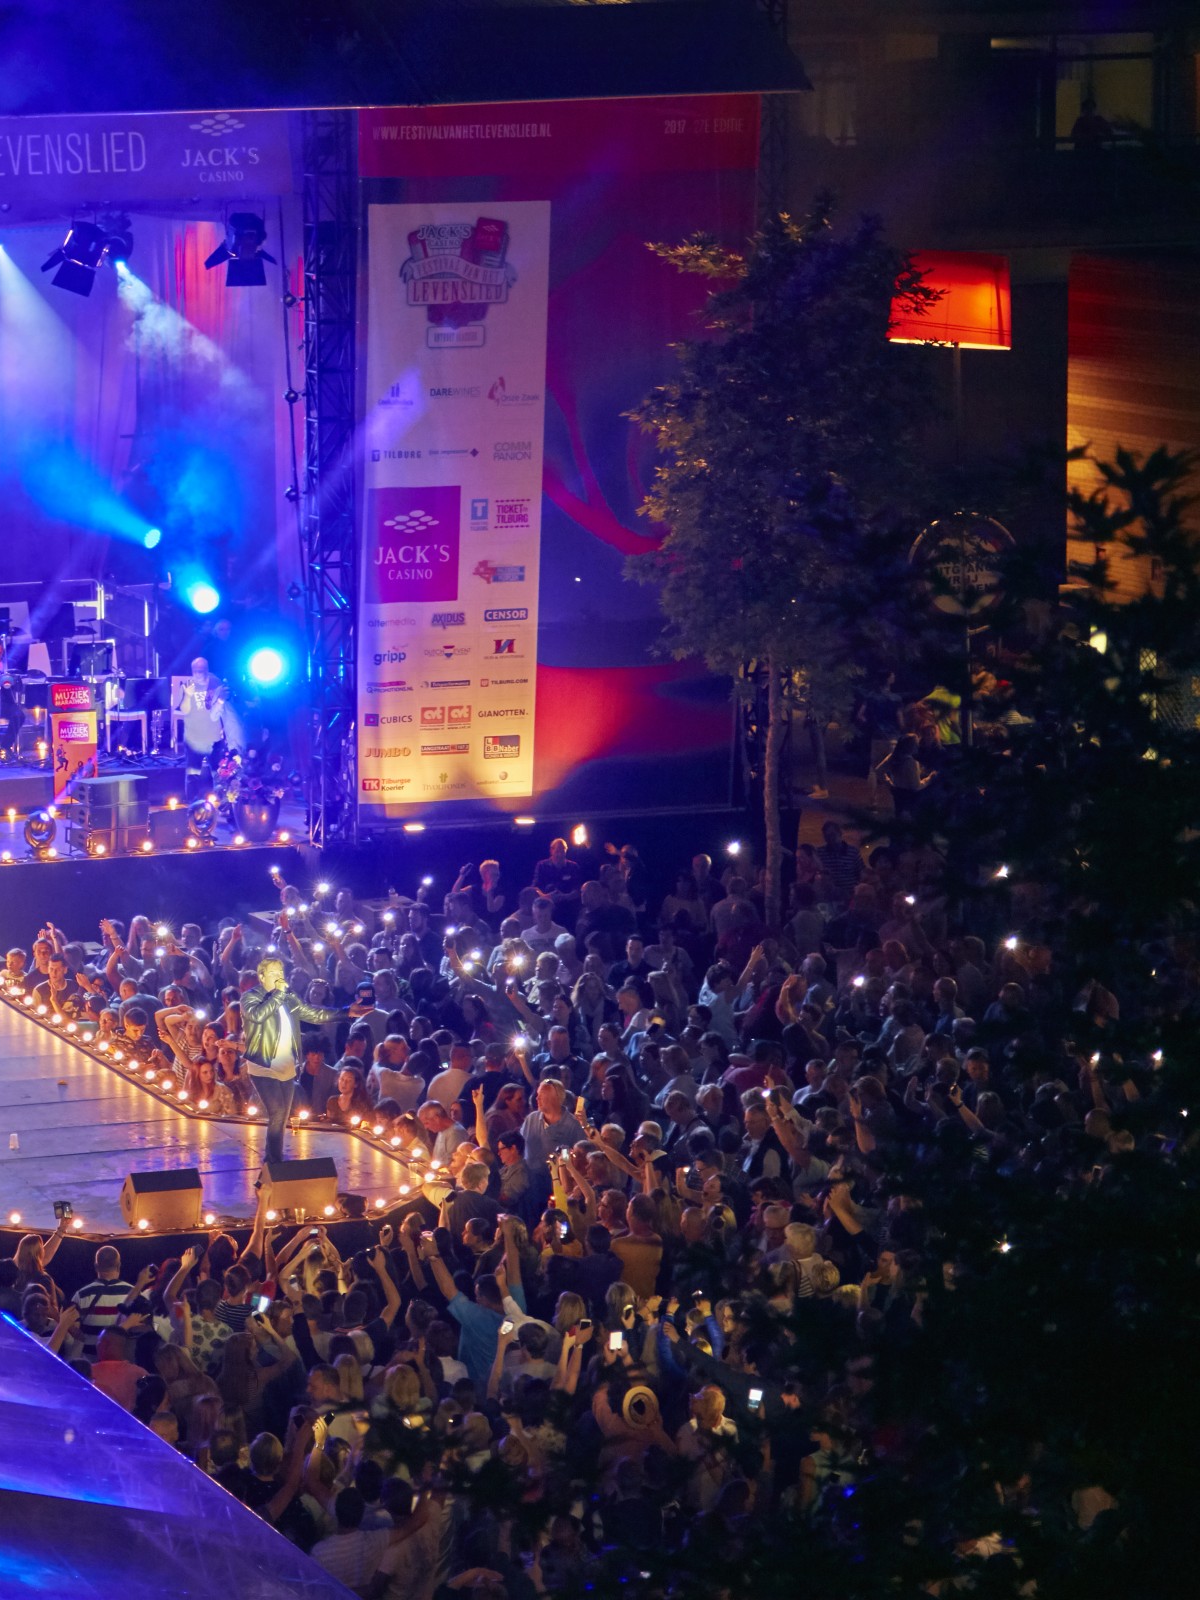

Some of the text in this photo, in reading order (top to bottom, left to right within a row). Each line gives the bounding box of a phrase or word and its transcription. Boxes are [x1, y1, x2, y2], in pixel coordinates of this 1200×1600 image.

[664, 119, 686, 134] 2017
[181, 146, 261, 167] JACK'S
[198, 170, 245, 183] CASINO
[417, 223, 472, 240] JACK'S
[412, 281, 503, 302] LEVENSLIED
[496, 504, 523, 515] TICKET
[495, 514, 529, 525] TILBURG
[374, 544, 451, 565] JACK'S
[388, 568, 434, 581] CASINO
[431, 612, 466, 627] AXIDUS
[484, 609, 527, 621] CENSOR
[373, 650, 407, 666] gripp
[55, 690, 89, 699] MUZIEK
[380, 714, 414, 725] CUBICS
[60, 726, 88, 734] MUZIEK
[364, 747, 412, 758] JUMBO
